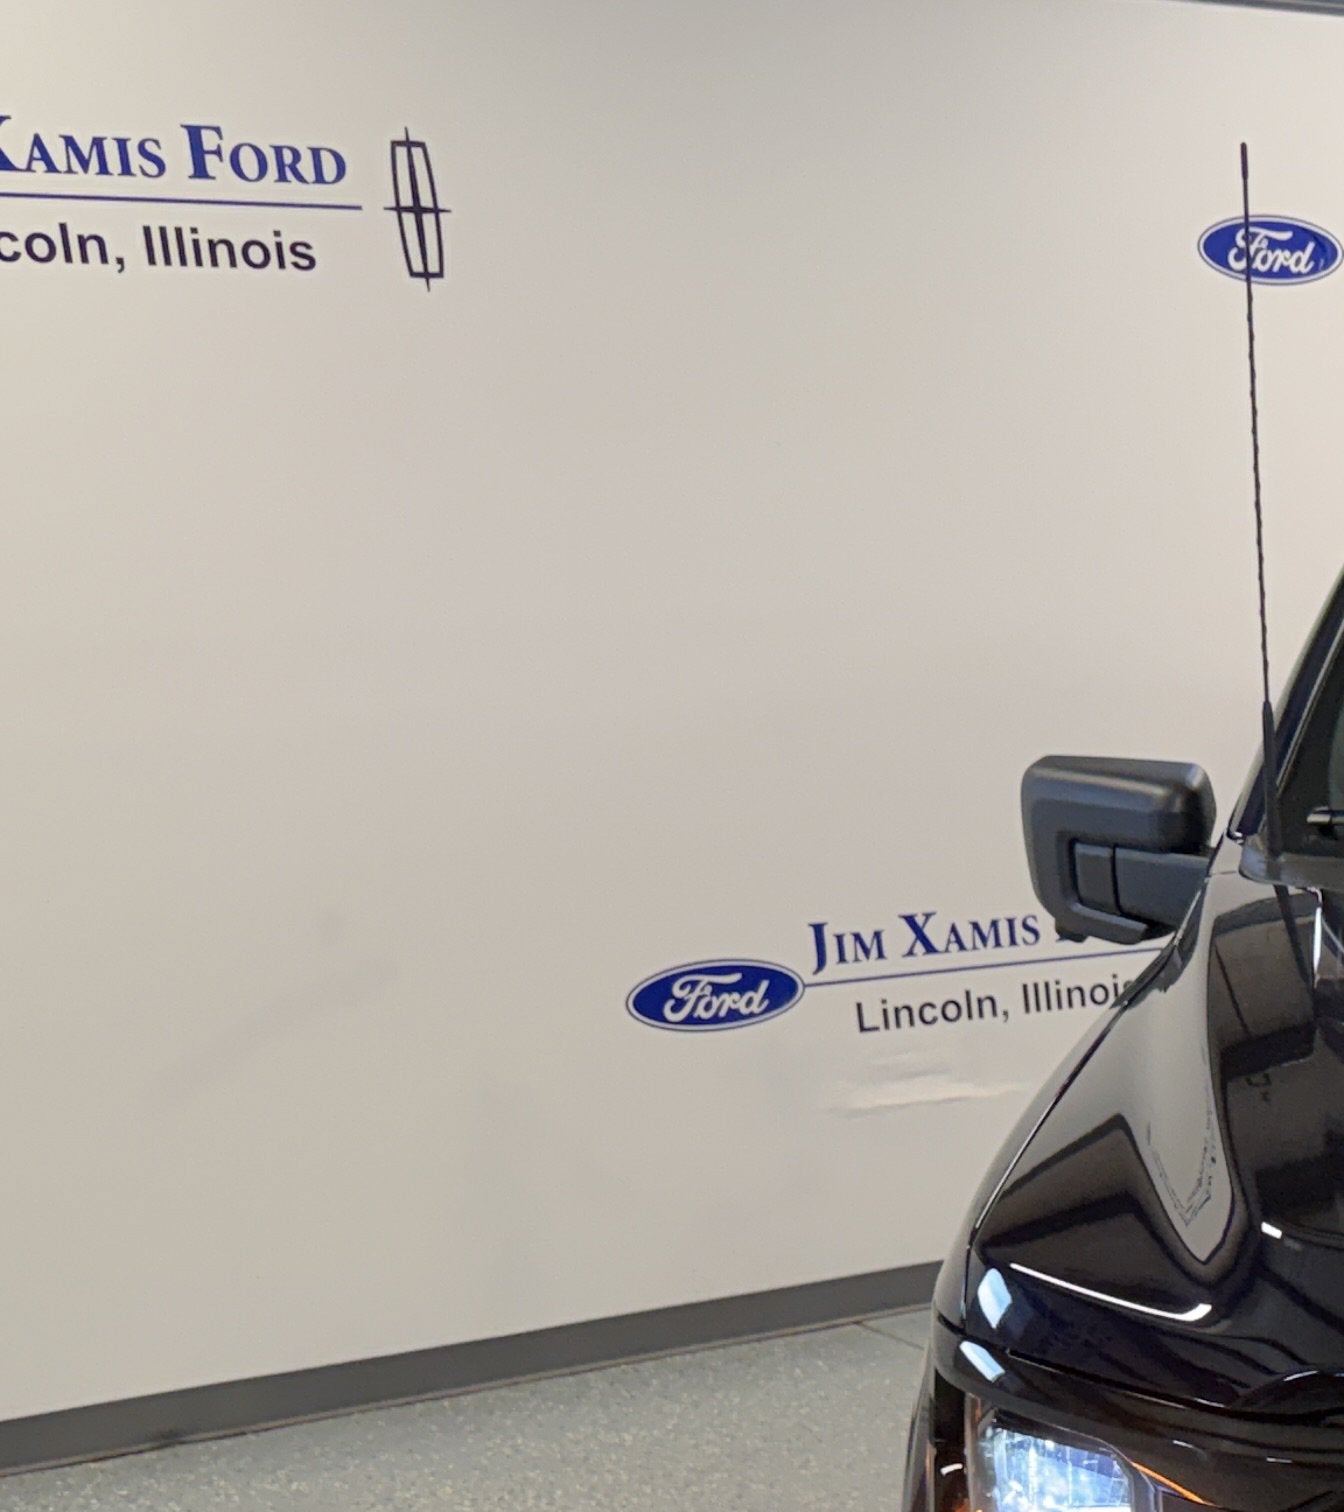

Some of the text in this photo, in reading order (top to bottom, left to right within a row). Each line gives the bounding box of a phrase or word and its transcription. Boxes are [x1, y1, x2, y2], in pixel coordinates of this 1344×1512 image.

[180, 124, 347, 185] FORD
[142, 225, 317, 272] Illinois
[1227, 226, 1315, 274] Ford
[808, 911, 1041, 976] JIM XAMIS
[663, 972, 770, 1023] Ford
[855, 989, 1009, 1034] Lincoln,
